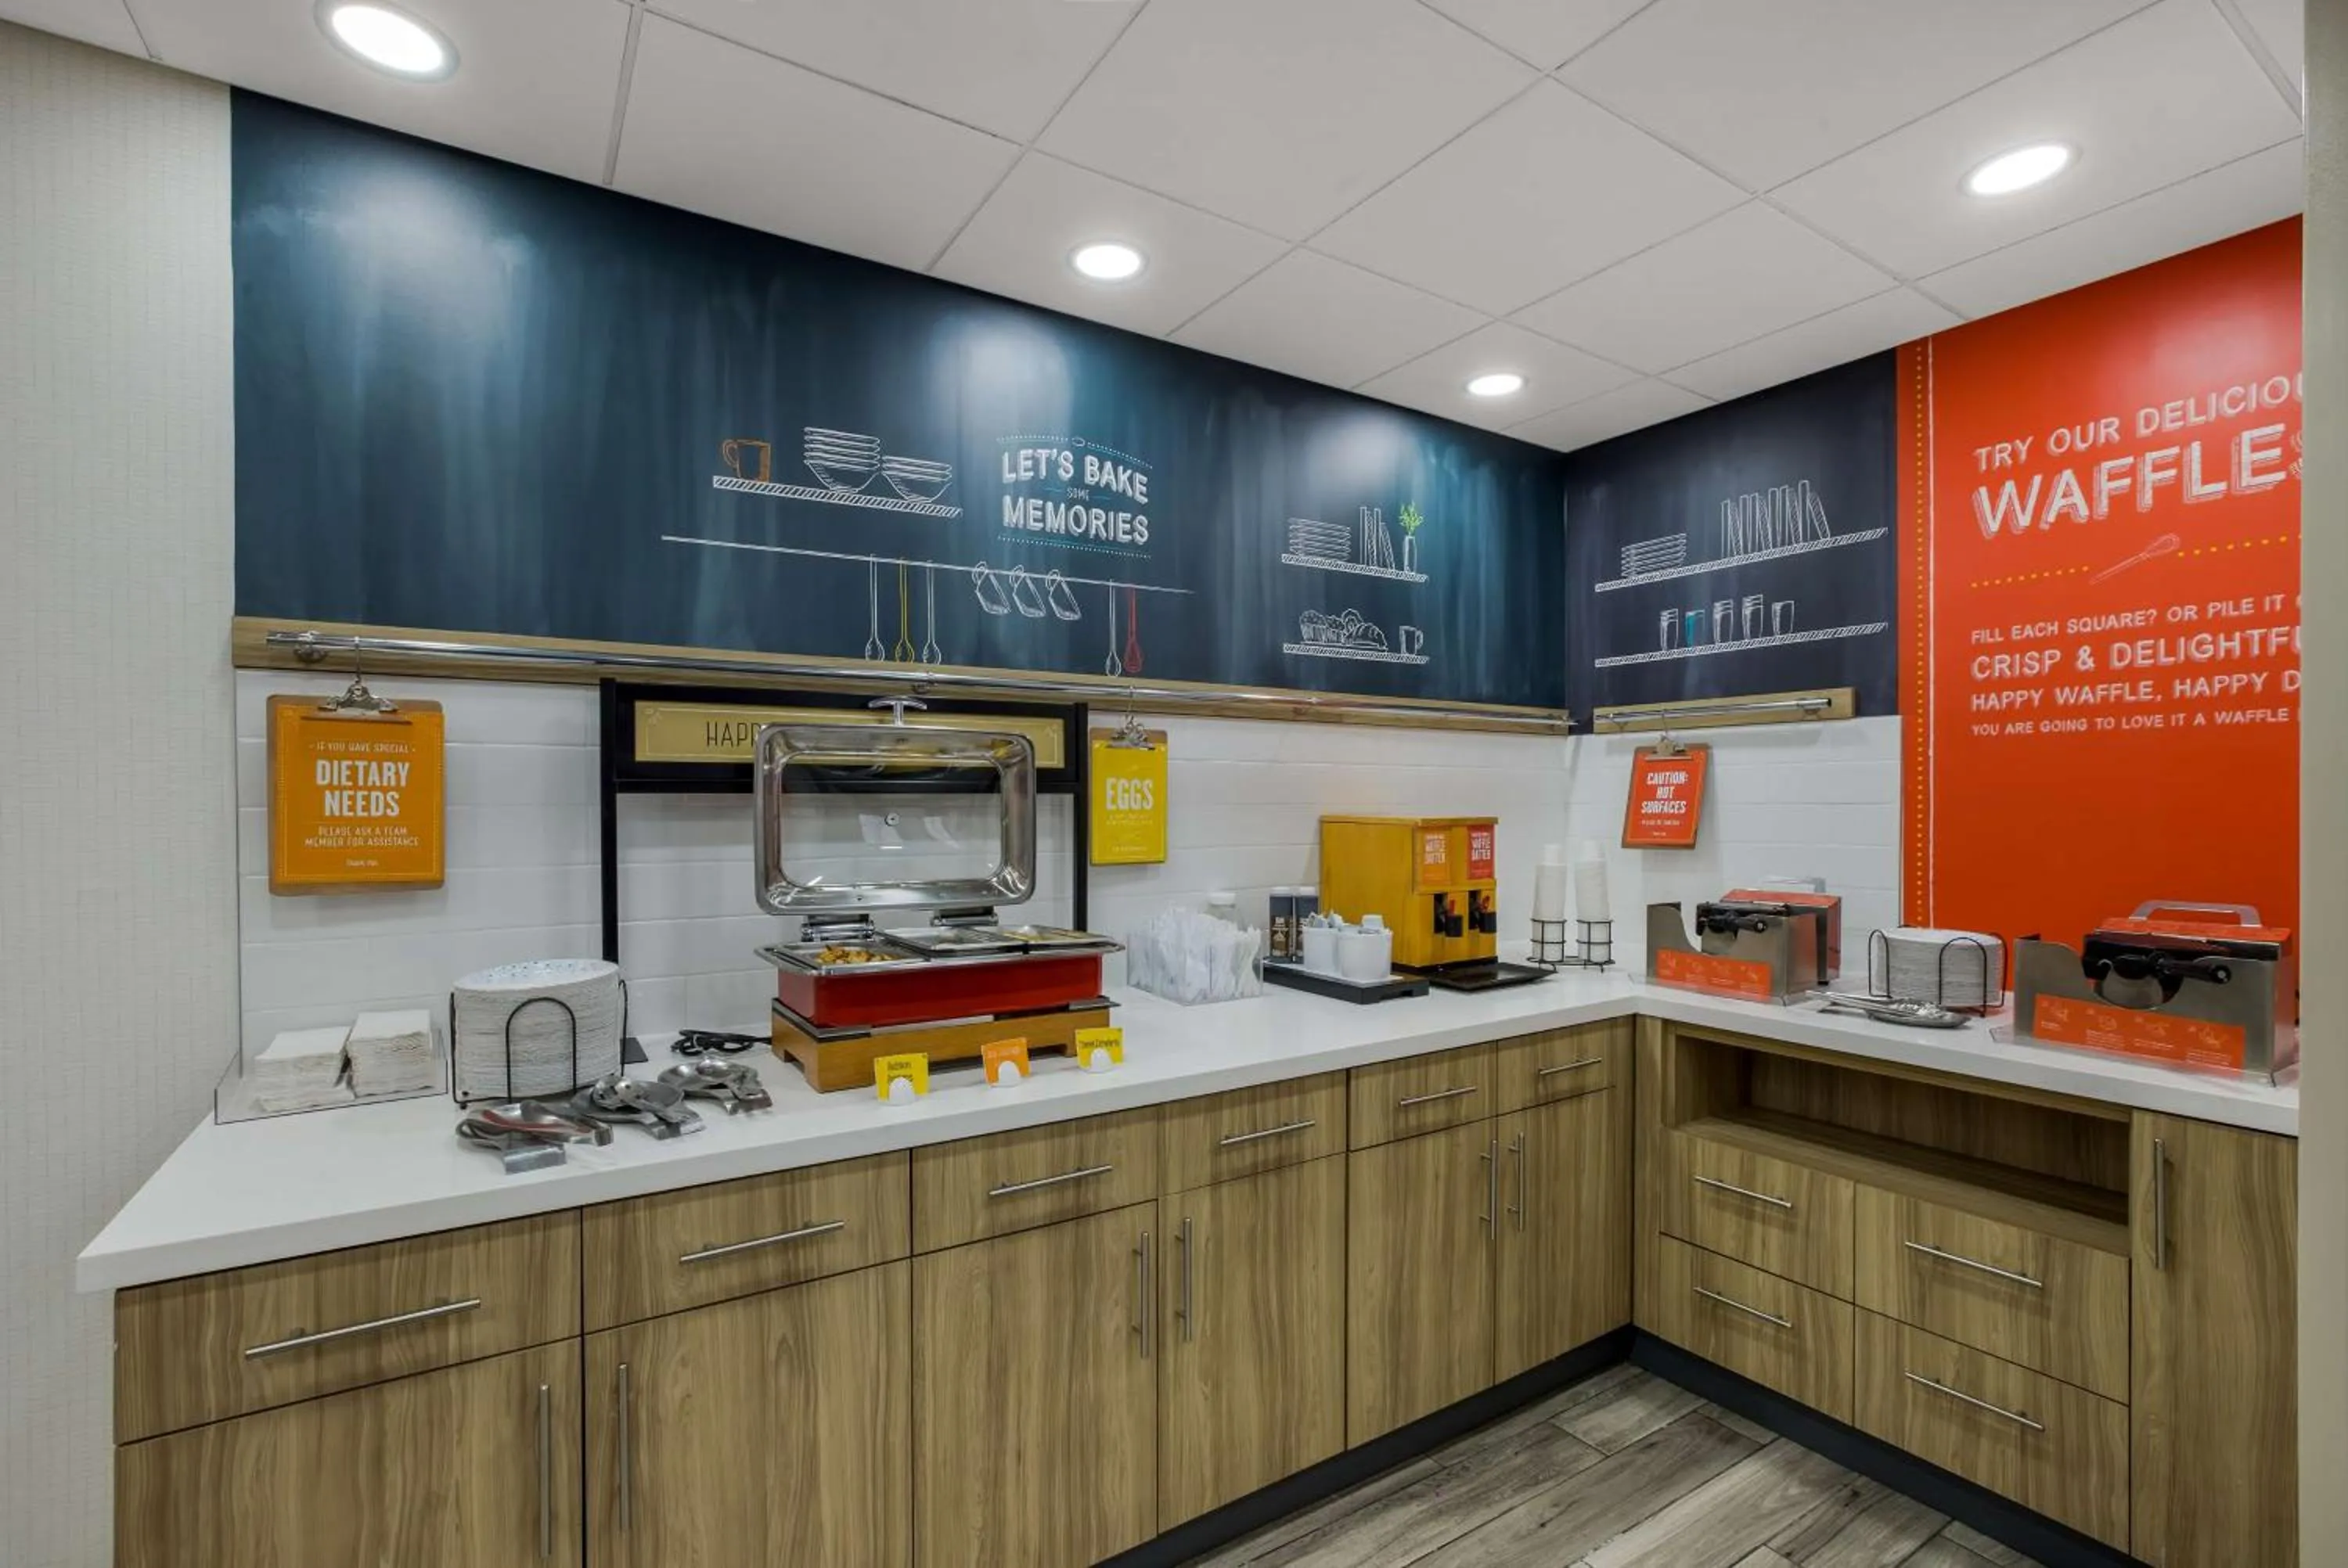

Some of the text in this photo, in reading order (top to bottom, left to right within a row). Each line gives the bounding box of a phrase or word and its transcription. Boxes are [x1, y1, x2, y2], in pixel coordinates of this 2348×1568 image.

[1974, 437, 2034, 473] TRY
[2047, 417, 2120, 455] OUR
[1002, 448, 1149, 505] LET'S BAKE
[1066, 487, 1090, 502] SOME
[1002, 494, 1149, 545] MEMORIES
[1972, 628, 2004, 645] FILL
[2011, 621, 2059, 640] EACH
[2066, 610, 2157, 635] SQUARE?
[2166, 604, 2198, 623] OR
[2207, 598, 2255, 618] PILE
[2263, 594, 2285, 612] IT
[1972, 649, 2062, 681] CRISP
[2076, 645, 2096, 672] &
[1972, 688, 2044, 711] HAPPY
[2055, 680, 2163, 704] WAFFLE,
[2173, 671, 2268, 697] HAPPY
[1972, 724, 2000, 736] YOU
[2004, 721, 2035, 735] ARE
[2040, 718, 2088, 733] GOING
[2094, 716, 2116, 730] TO
[2122, 714, 2164, 729] LOVE
[2170, 713, 2186, 727] IT
[2192, 712, 2206, 726] A
[2213, 708, 2290, 725] WAFFLE
[317, 741, 409, 754] IF YOU HAVE SPECIAL
[316, 760, 410, 786] DIETARY
[325, 790, 400, 817] NEEDS
[1106, 776, 1154, 811] EGGS
[1656, 786, 1675, 799] HOT
[1640, 800, 1687, 815] SURFACES
[304, 836, 420, 847] MEMBER FOR ASSISTANCE
[319, 826, 351, 836] PLEASE
[355, 826, 372, 836] ASK
[384, 825, 408, 836] TEAM
